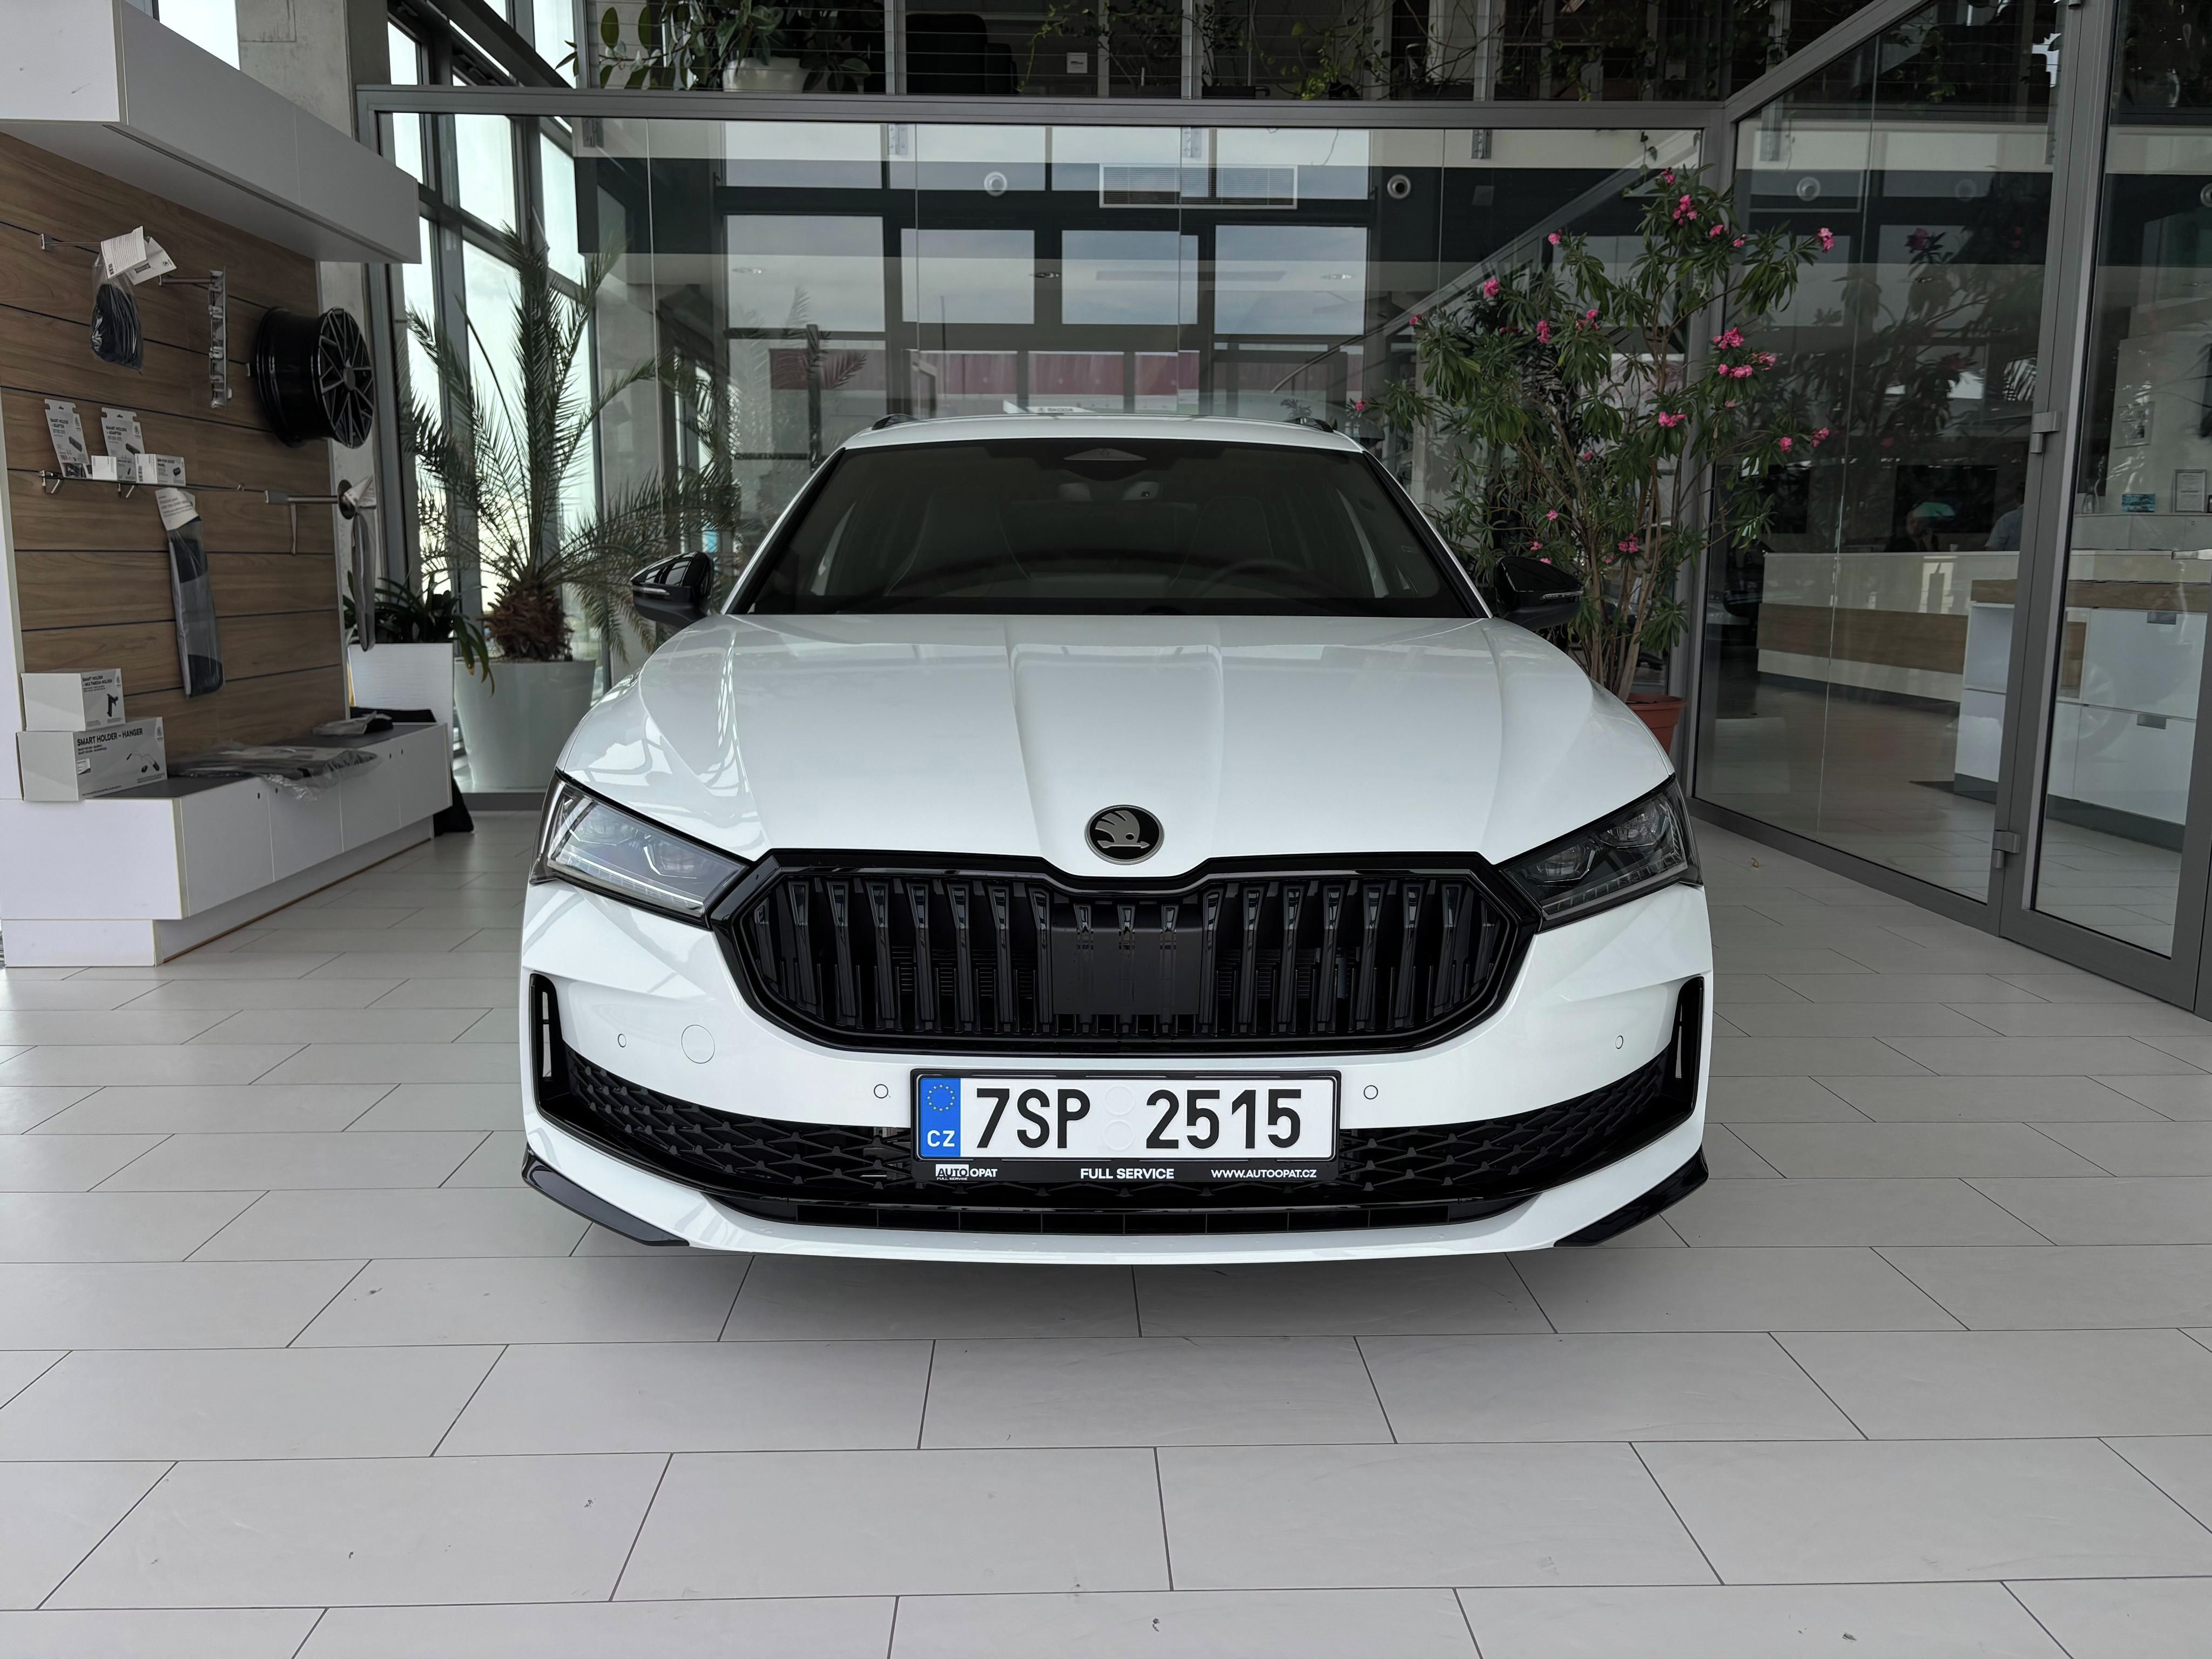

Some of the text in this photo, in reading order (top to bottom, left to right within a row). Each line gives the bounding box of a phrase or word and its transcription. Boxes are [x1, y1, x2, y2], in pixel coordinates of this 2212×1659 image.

[77, 736, 96, 746] SMART
[97, 732, 118, 743] HOLDER
[122, 728, 143, 738] HANGER
[976, 1088, 1301, 1150] 7SP 2515
[927, 1129, 955, 1148] CZ
[1081, 1168, 1175, 1179] FULL SERVICE
[1211, 1169, 1317, 1178] WWW.AUTOOPAT.CZ
